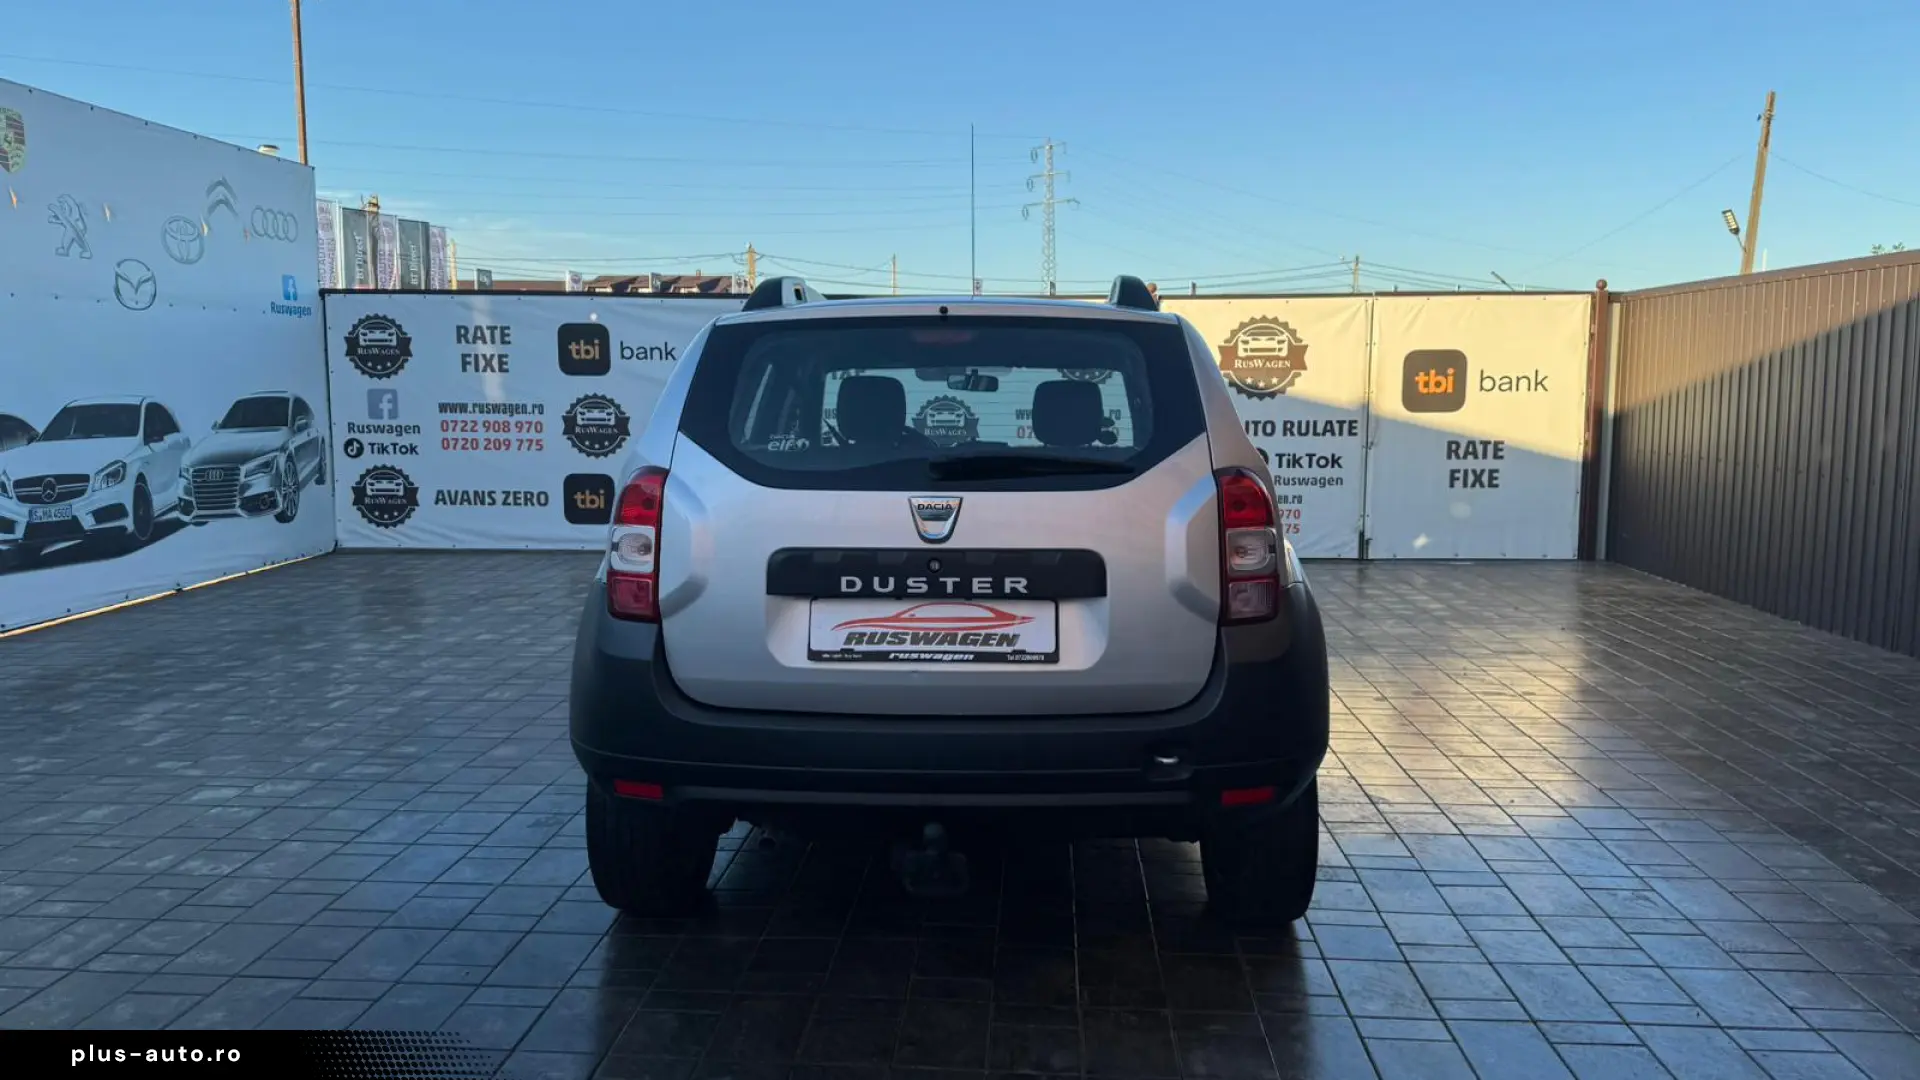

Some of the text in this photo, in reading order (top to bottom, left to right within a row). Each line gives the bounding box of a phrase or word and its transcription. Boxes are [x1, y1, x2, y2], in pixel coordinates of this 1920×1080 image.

[271, 301, 312, 318] Ruswagen
[456, 325, 511, 345] RATE
[568, 339, 600, 360] tbi
[620, 341, 677, 361] bank
[461, 353, 510, 373] FIXE
[1414, 368, 1455, 394] tbi
[1479, 369, 1549, 392] bank
[438, 402, 545, 418] www.ruswagen.ro
[347, 421, 421, 437] Ruswagen
[440, 420, 544, 434] 0722 908 970
[1245, 420, 1359, 437] TO RULATE
[367, 442, 419, 456] TikTok
[441, 437, 545, 451] 0720 209 775
[1446, 440, 1506, 461] RATE
[1275, 453, 1344, 469] TikTok
[1274, 475, 1344, 488] Ruswagen
[1448, 468, 1500, 489] FIXE
[434, 489, 550, 506] AVANS ZERO
[573, 489, 605, 509] tbi
[917, 503, 953, 511] DACIA
[1284, 523, 1301, 534] 75
[840, 576, 1028, 594] DUSTER
[843, 631, 1020, 648] RUSWAGEN
[888, 652, 975, 663] ruswagen
